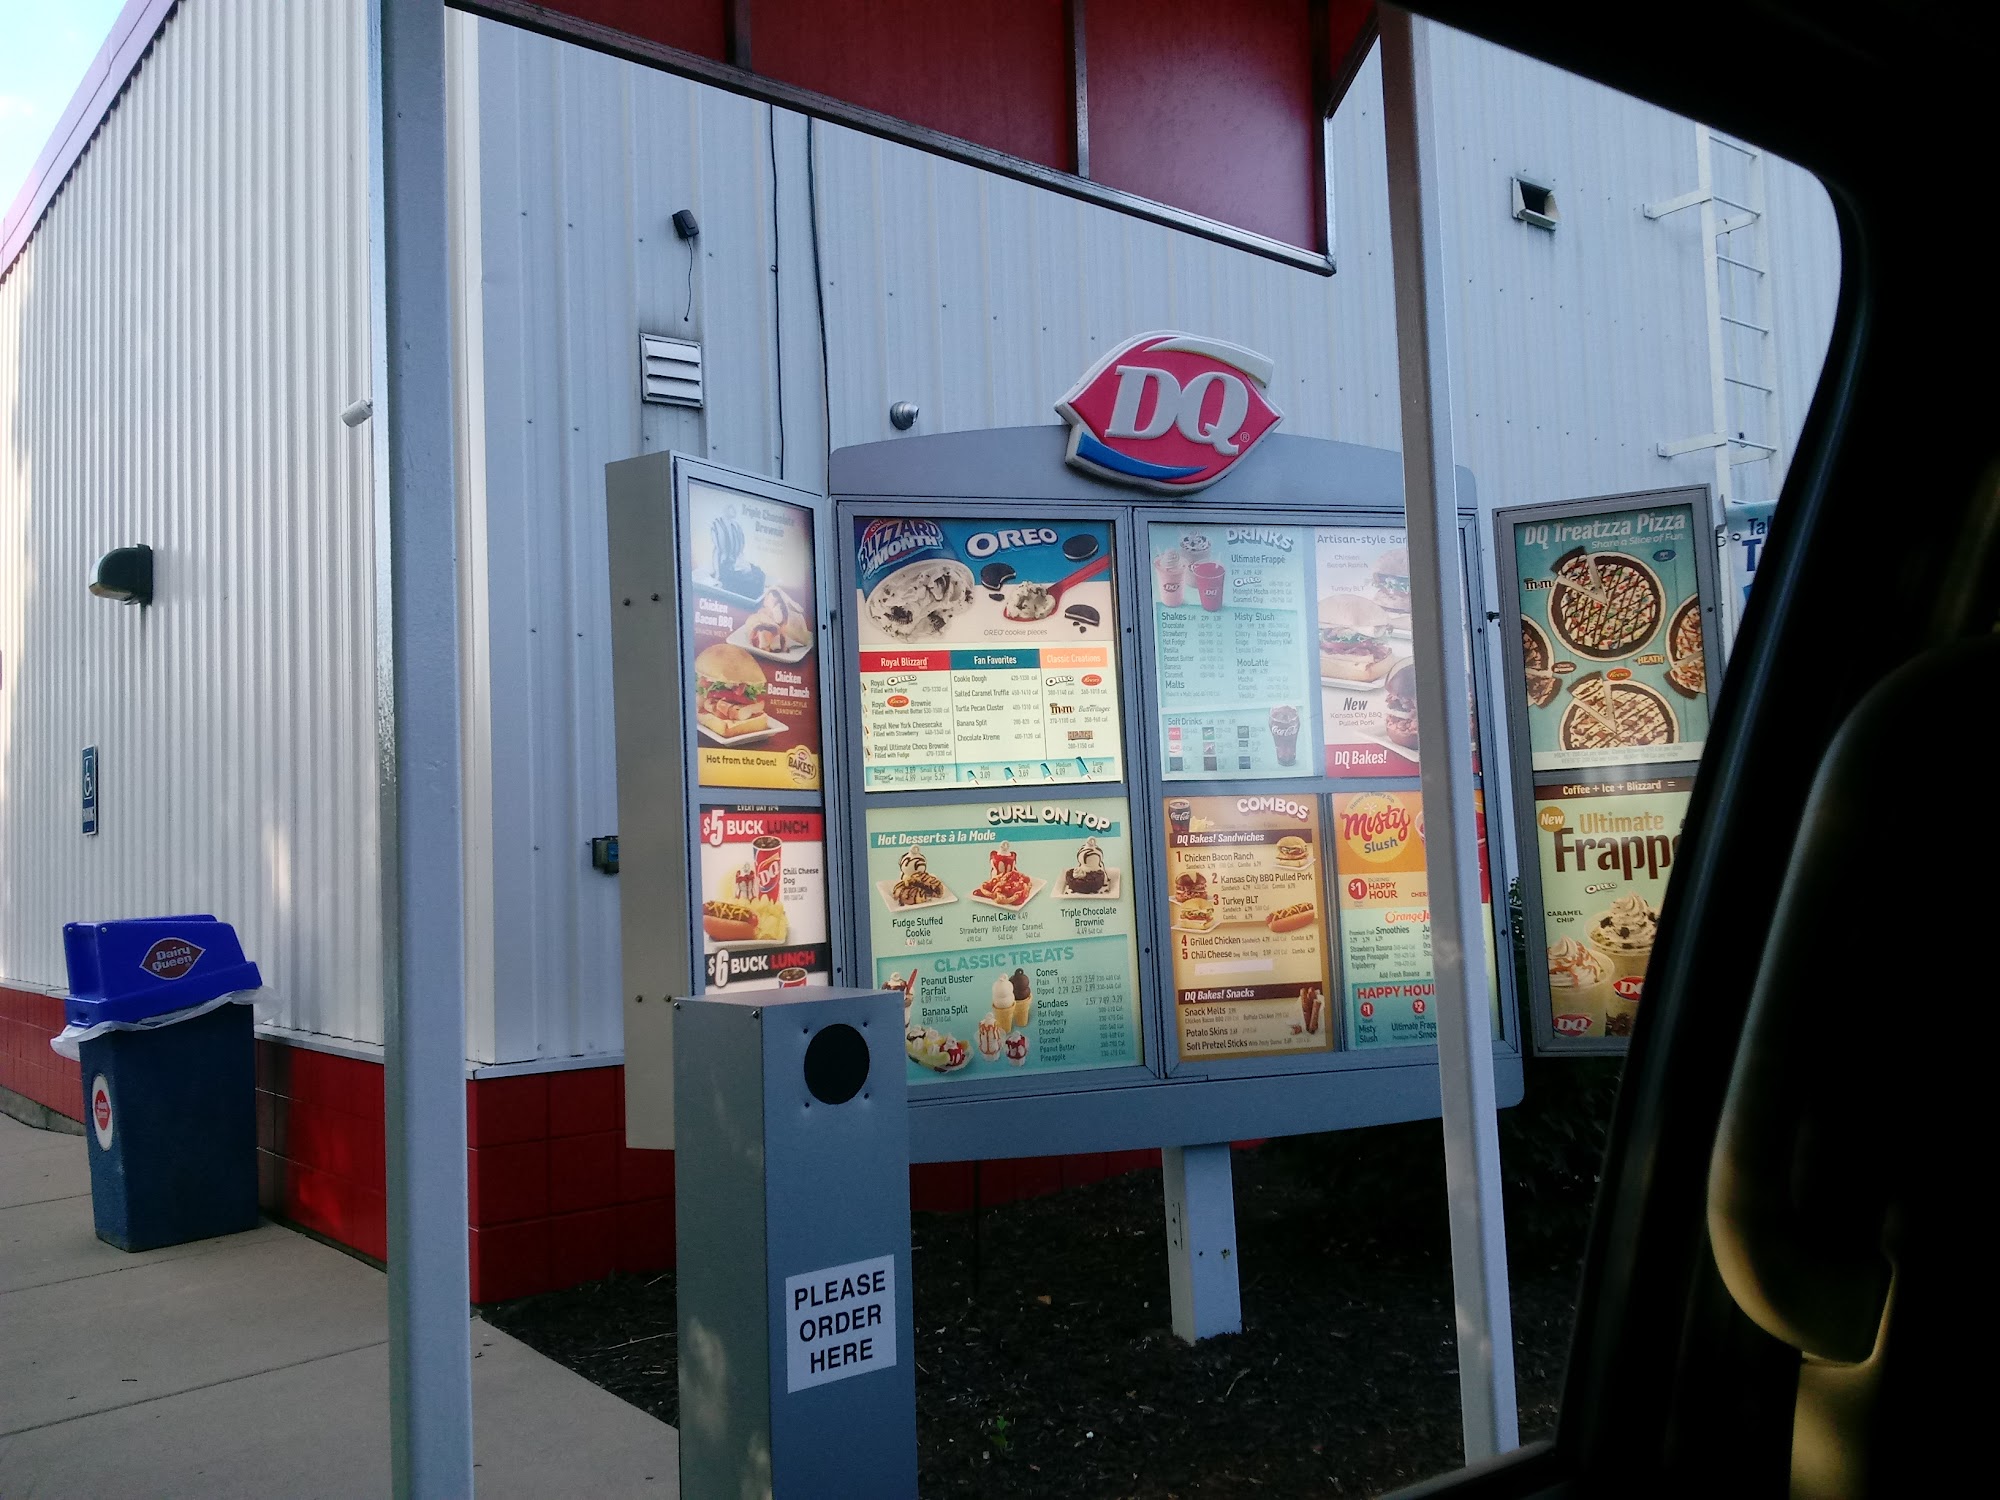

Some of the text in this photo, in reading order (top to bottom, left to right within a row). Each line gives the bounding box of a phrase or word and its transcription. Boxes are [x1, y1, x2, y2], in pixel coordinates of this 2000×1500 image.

[1105, 365, 1239, 455] DQ
[1525, 513, 1685, 550] DQ Treatzza Pizza
[966, 528, 1058, 558] OREO
[1226, 528, 1294, 551] DRINKS
[1317, 534, 1386, 545] Artisan-style
[1591, 539, 1618, 550] Share
[1629, 535, 1651, 546] Slice
[1653, 534, 1664, 544] of
[873, 535, 938, 570] MONTH
[1231, 554, 1285, 565] Ultimate Frappé
[699, 598, 729, 614] Chicken
[716, 616, 733, 631] BBQ
[1162, 613, 1187, 621] Shakes
[1235, 613, 1253, 621] Misty
[881, 657, 927, 668] Royal Blizzard
[974, 655, 1017, 665] Fan Favorites
[1637, 655, 1664, 664] HEATH
[775, 671, 802, 684] Chicken
[971, 675, 987, 683] Dough
[768, 683, 810, 698] Bacon Ranch
[1165, 681, 1184, 689] Malts
[1343, 697, 1368, 711] New
[976, 719, 987, 727] Split
[706, 755, 777, 766] Hot from the Oven!
[789, 757, 813, 775] BAKES!
[1335, 750, 1387, 769] DQ Bakes!
[1562, 780, 1662, 796] Coffee Ice Blizzard
[1237, 797, 1310, 822] COMBOS
[986, 805, 1111, 832] CURL ON TOP
[1340, 804, 1410, 842] Misty
[1540, 812, 1564, 825] New
[1579, 812, 1664, 834] Ultimate
[704, 810, 809, 846] $5 BUCK LUNCH
[878, 830, 996, 845] Hot Desserts à la Mode
[1177, 833, 1264, 846] DQ Bakes! Sandwiches
[1364, 837, 1398, 853] Slush
[1176, 851, 1254, 863] 1 Chicken Bacon Ranch
[1212, 873, 1218, 884] 2
[1221, 875, 1245, 884] Kansas
[1246, 875, 1258, 884] City
[1259, 874, 1274, 882] BBQ
[1297, 872, 1312, 880] Pork
[1351, 882, 1361, 896] $1
[1369, 890, 1398, 899] HOUR
[1585, 882, 1617, 894] OREO
[1213, 895, 1258, 907] 3 Turkey BLT
[972, 912, 1016, 923] Funnel Cake
[1061, 907, 1117, 917] Triple Chocolate
[892, 916, 943, 928] Fudge Stuffed
[1022, 923, 1043, 931] Caramel
[1075, 918, 1104, 927] Brownie
[906, 928, 931, 938] Cookie
[960, 927, 988, 935] Strawberry
[1181, 935, 1240, 946] 4 Grilled Chicken
[156, 946, 191, 962] Dairy
[934, 947, 1074, 972] CLASSIC TREATS
[1182, 949, 1188, 960] 5
[1191, 951, 1206, 959] Chili
[151, 954, 193, 972] Queen
[708, 950, 815, 988] $6 BUCK LUNCH
[921, 975, 973, 986] Peanut Buster
[921, 986, 947, 996] Parfait
[1185, 989, 1254, 1003] DQ Bakes! Snacks
[1357, 986, 1400, 999] HAPPY
[1037, 999, 1068, 1008] Sundaes
[922, 1005, 968, 1016] Banana Split
[1185, 1007, 1225, 1016] Snack Melts
[1391, 1022, 1418, 1031] Ultimate
[1556, 1015, 1588, 1032] DQ
[1186, 1028, 1208, 1038] Potato
[1210, 1027, 1228, 1036] Skins
[1187, 1039, 1247, 1051] Soft Pretzel Sticks
[794, 1270, 886, 1311] PLEASE
[800, 1304, 882, 1342] ORDER
[811, 1338, 873, 1374] HERE
